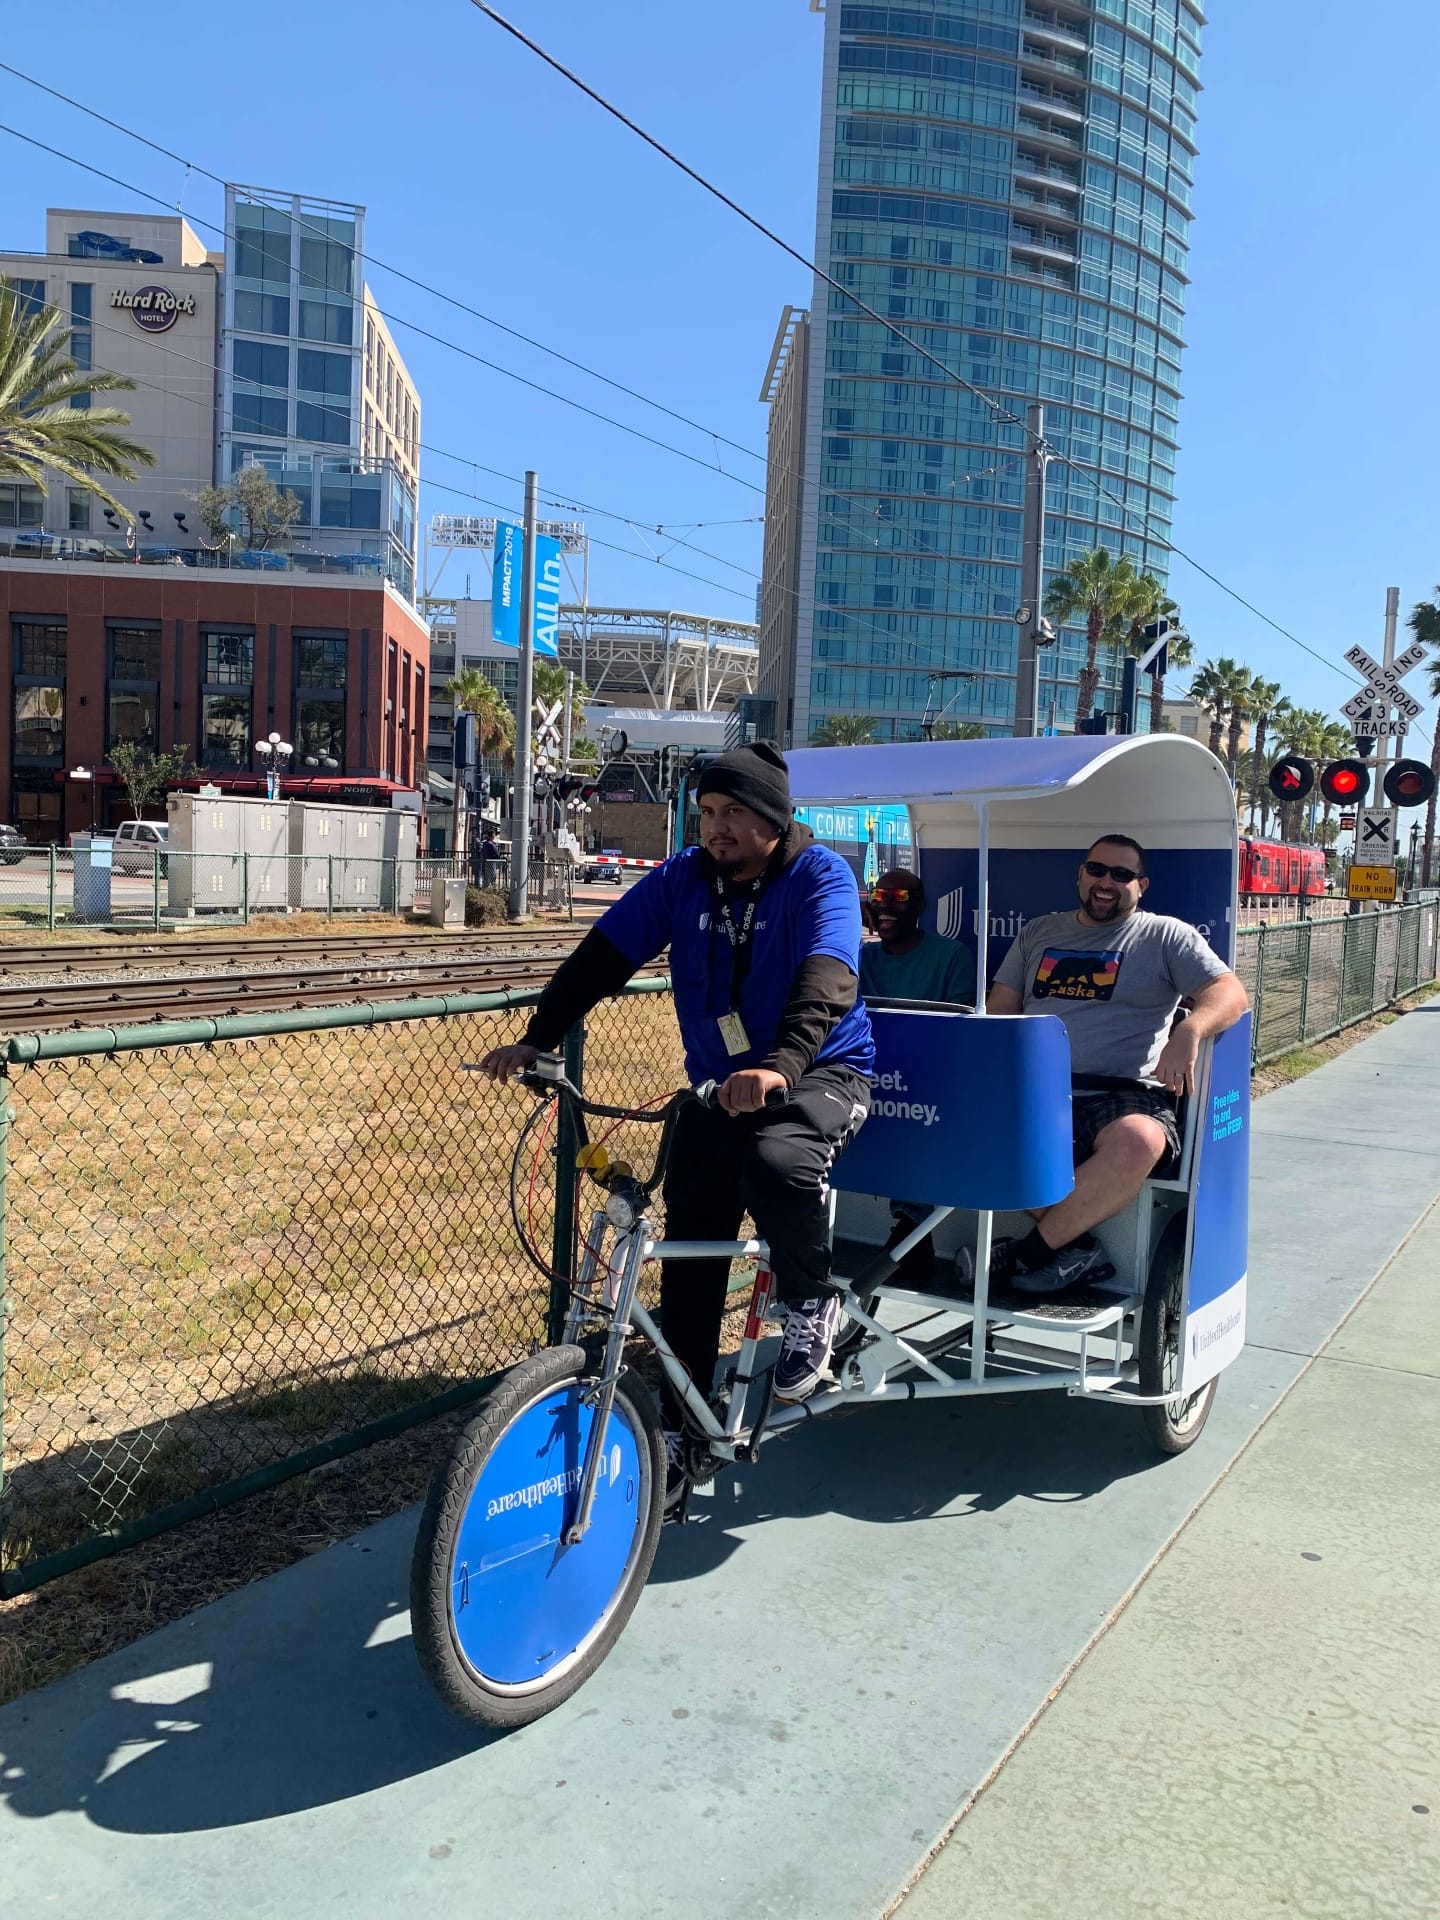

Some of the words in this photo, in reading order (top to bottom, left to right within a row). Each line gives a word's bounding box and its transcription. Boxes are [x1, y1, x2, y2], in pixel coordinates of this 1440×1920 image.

[111, 289, 153, 308] Hard
[155, 292, 195, 315] Rock
[140, 314, 165, 323] HOTEL
[537, 553, 560, 594] In.
[536, 601, 559, 653] All
[1345, 647, 1423, 717] CROSSING
[1376, 705, 1386, 719] 3
[1353, 721, 1407, 735] TRACKS
[816, 813, 854, 837] COME
[1365, 871, 1380, 881] NO
[1351, 884, 1371, 893] TRAIN
[1374, 885, 1393, 894] HORN
[743, 902, 755, 930] adidas
